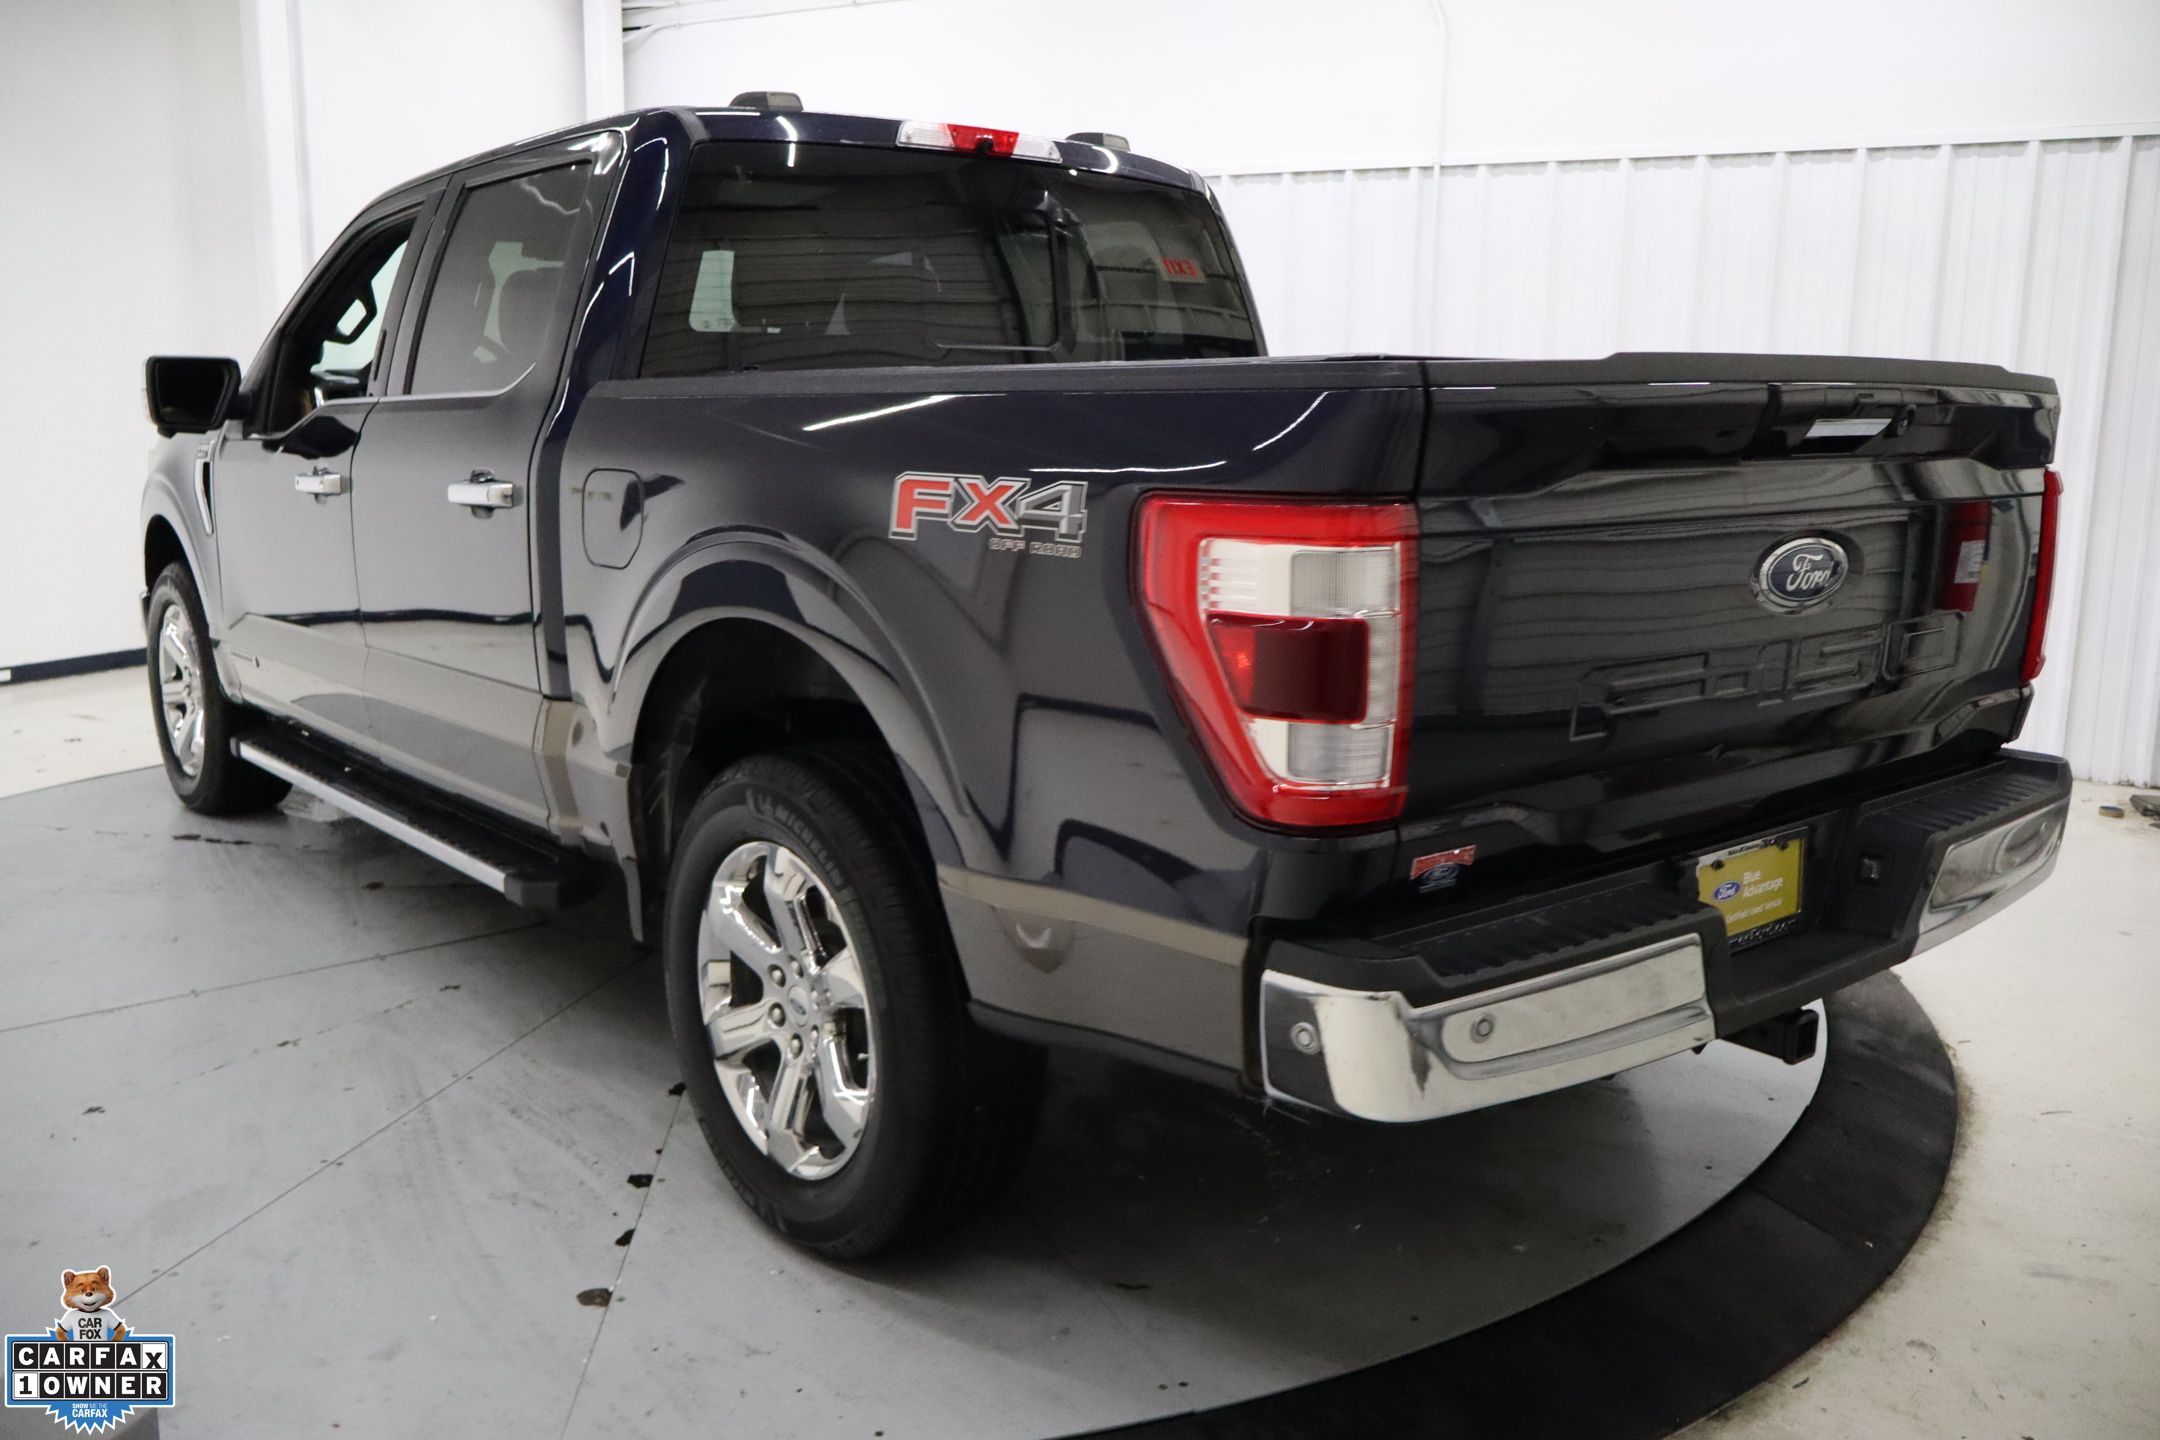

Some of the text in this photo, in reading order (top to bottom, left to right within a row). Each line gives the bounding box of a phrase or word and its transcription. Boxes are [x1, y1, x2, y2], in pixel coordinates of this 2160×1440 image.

[888, 471, 1088, 543] FX4
[989, 537, 1082, 558] OFF ROAD
[1785, 553, 1839, 591] Ford
[1569, 611, 1964, 741] F-150
[1743, 871, 1761, 885] Blue
[1743, 877, 1784, 897] Advantage
